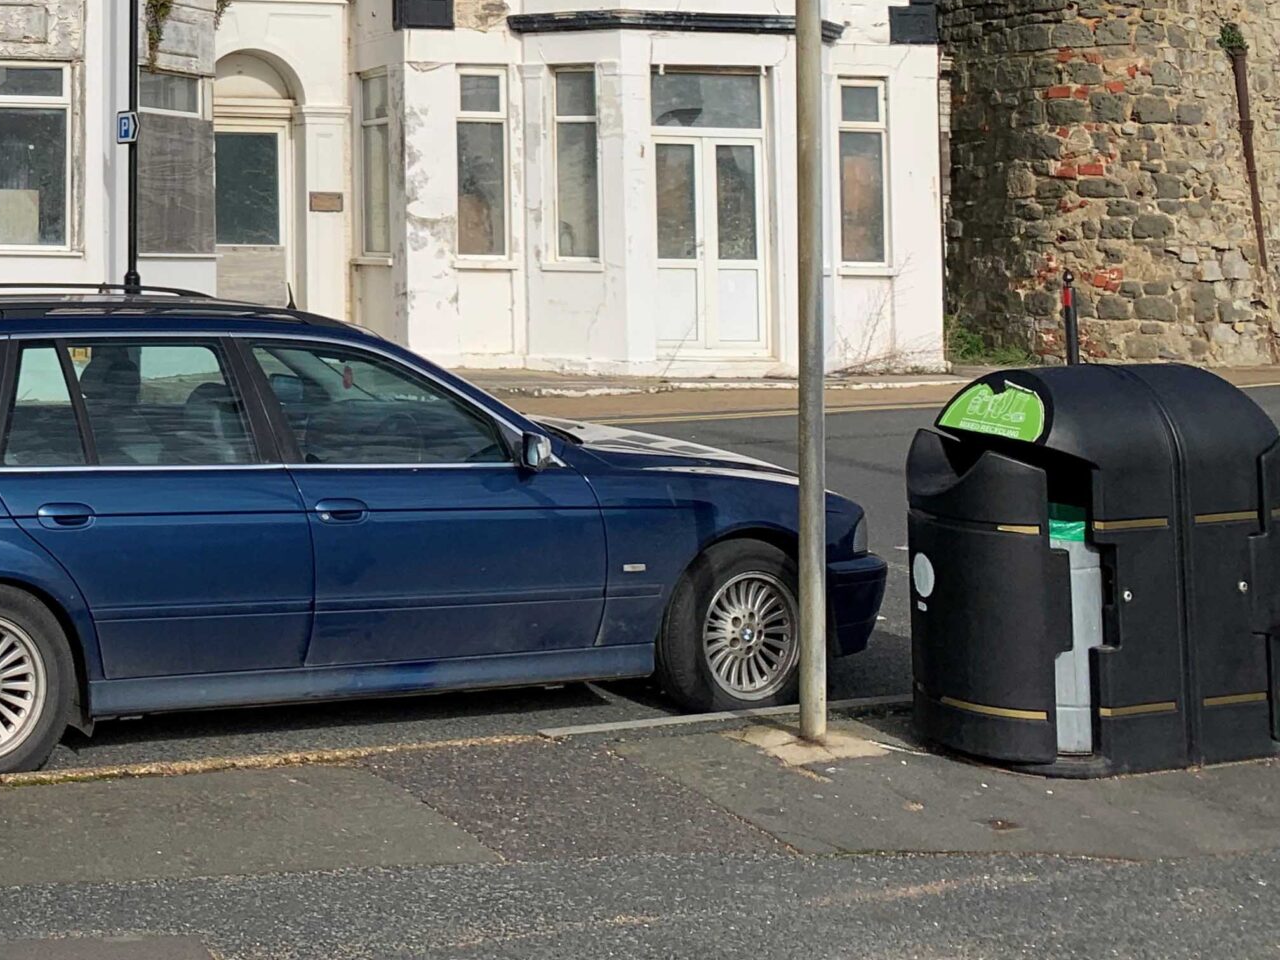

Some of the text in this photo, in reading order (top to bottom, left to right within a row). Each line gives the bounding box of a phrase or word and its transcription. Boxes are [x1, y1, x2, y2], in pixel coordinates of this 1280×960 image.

[121, 119, 129, 137] P
[959, 420, 1020, 438] MIXED RECYCLING
